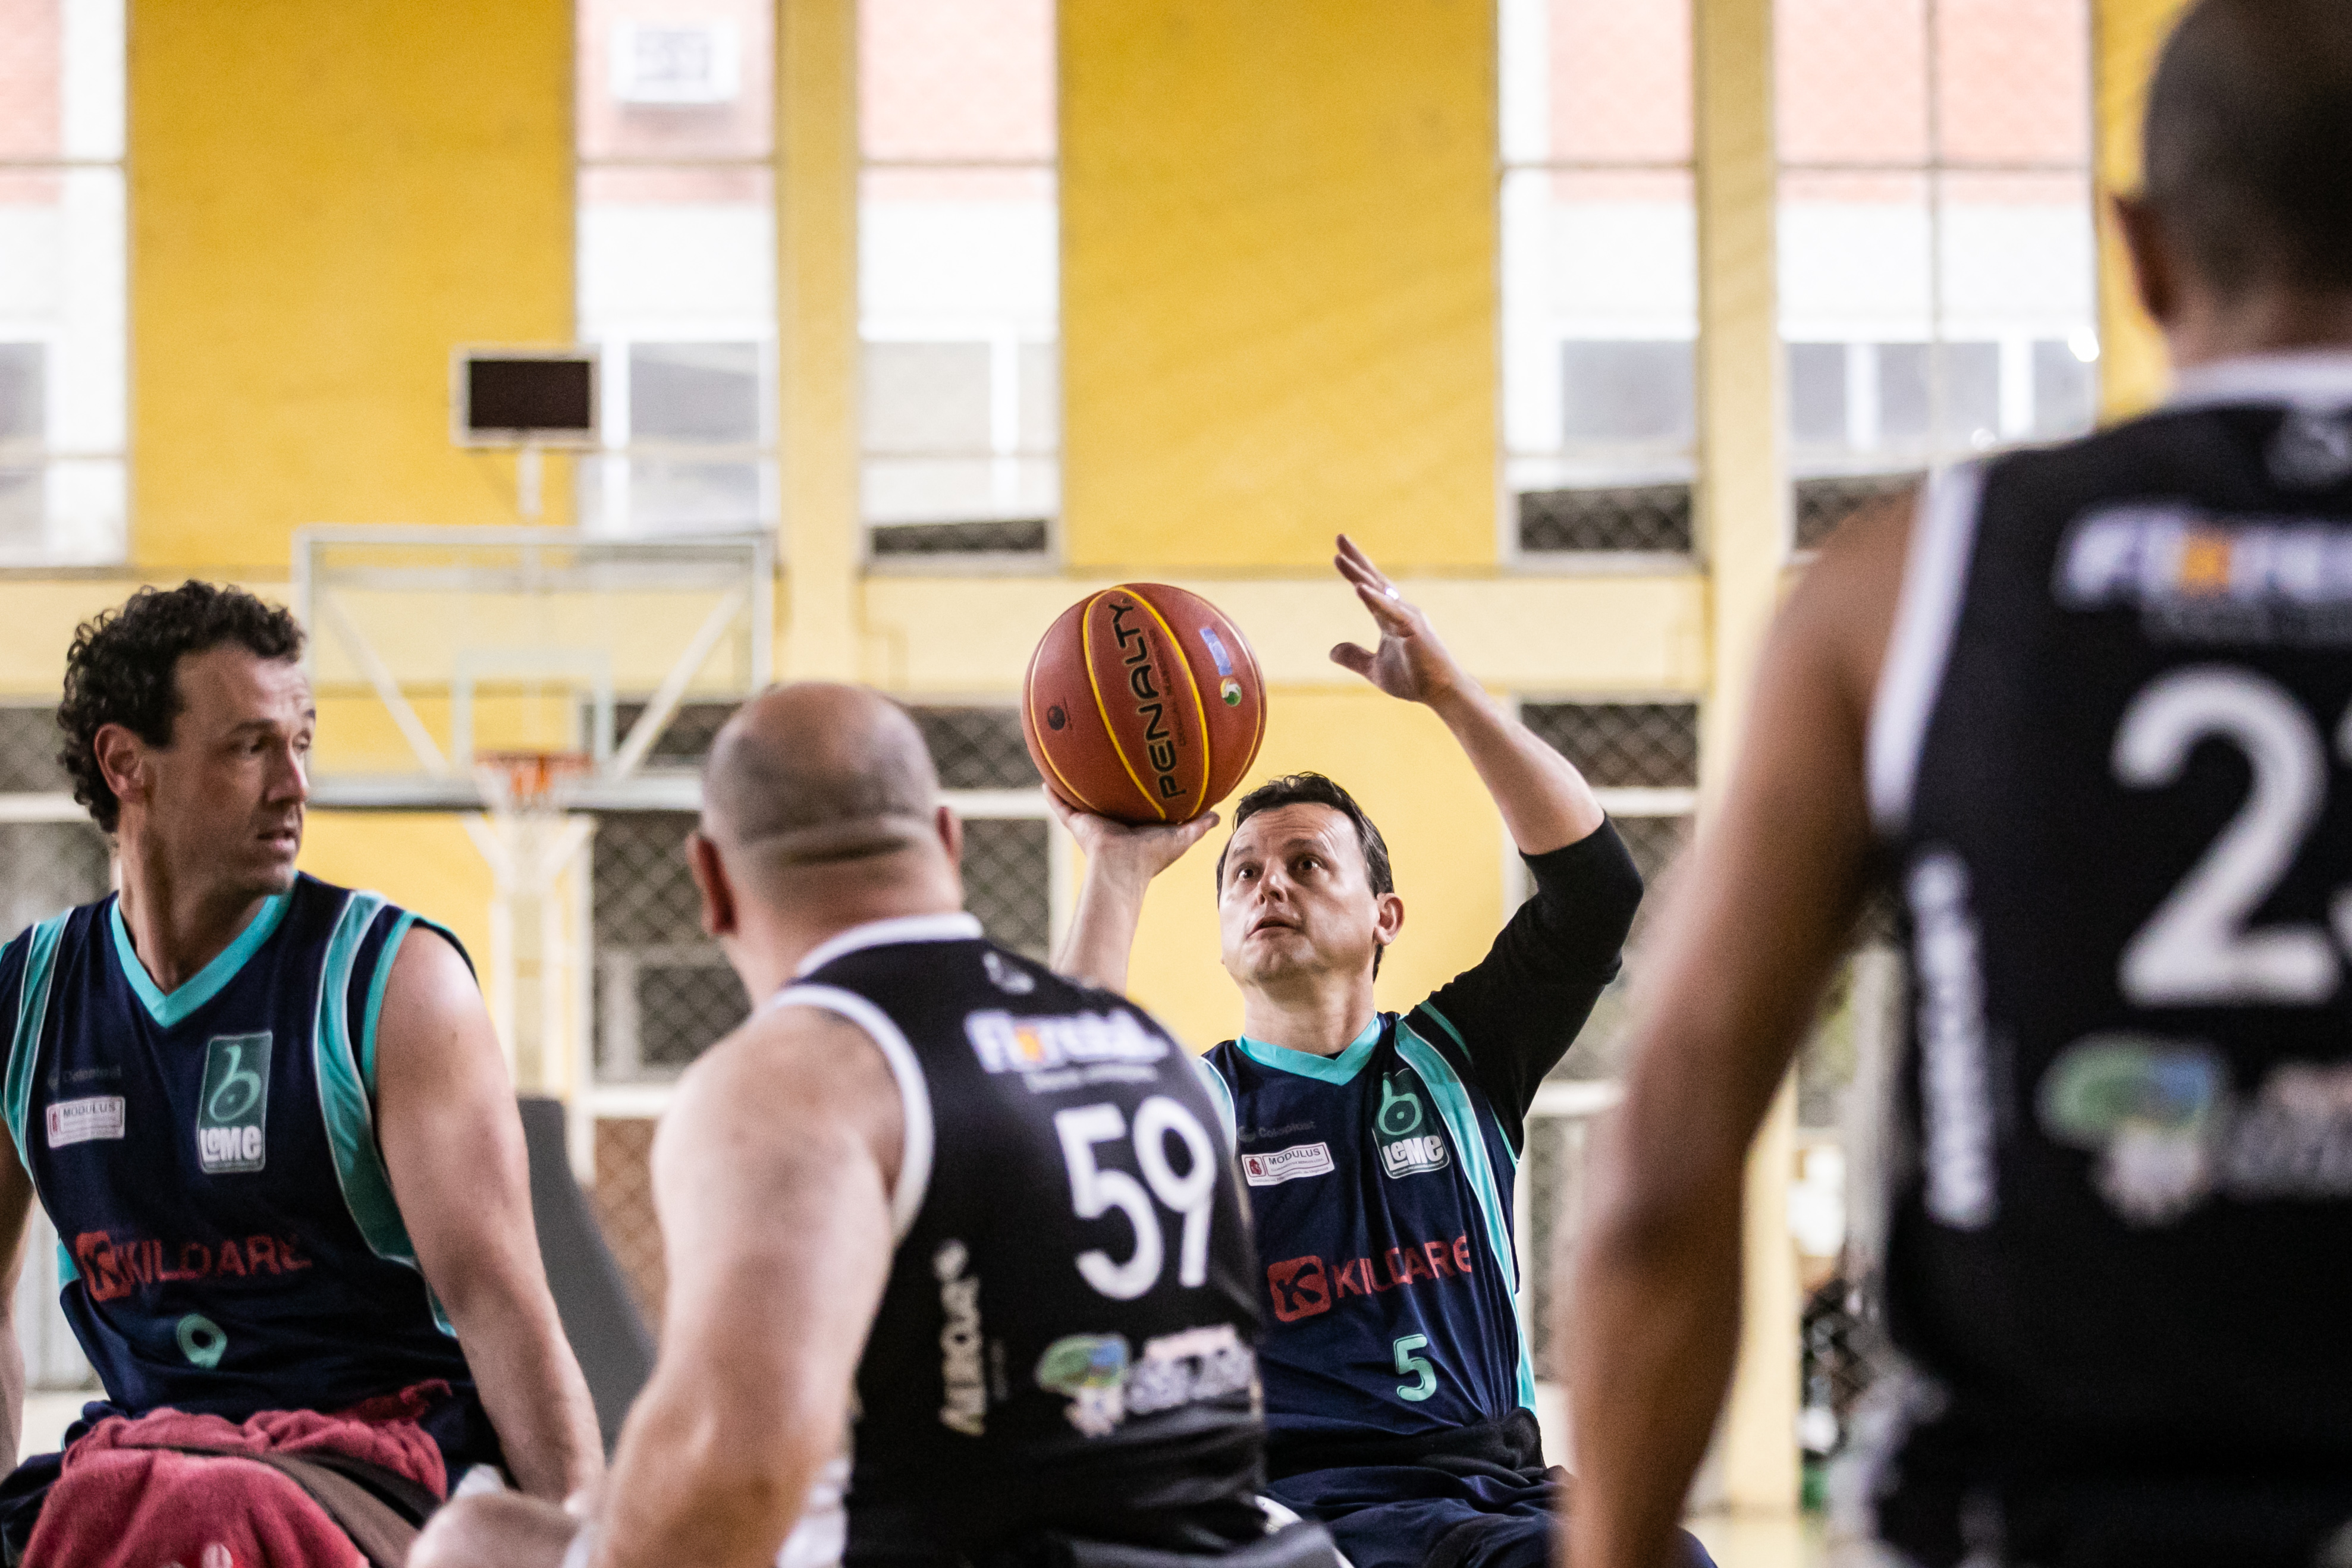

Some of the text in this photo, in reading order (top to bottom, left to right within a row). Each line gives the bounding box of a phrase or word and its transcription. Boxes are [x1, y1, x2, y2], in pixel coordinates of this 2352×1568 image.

[1107, 602, 1187, 800] PENALTY
[2110, 661, 2352, 1008] 2
[63, 1101, 116, 1118] MODULUS
[1268, 1148, 1321, 1165] MODULUS
[1054, 1095, 1217, 1301] 59
[1393, 1334, 1437, 1402] 5
